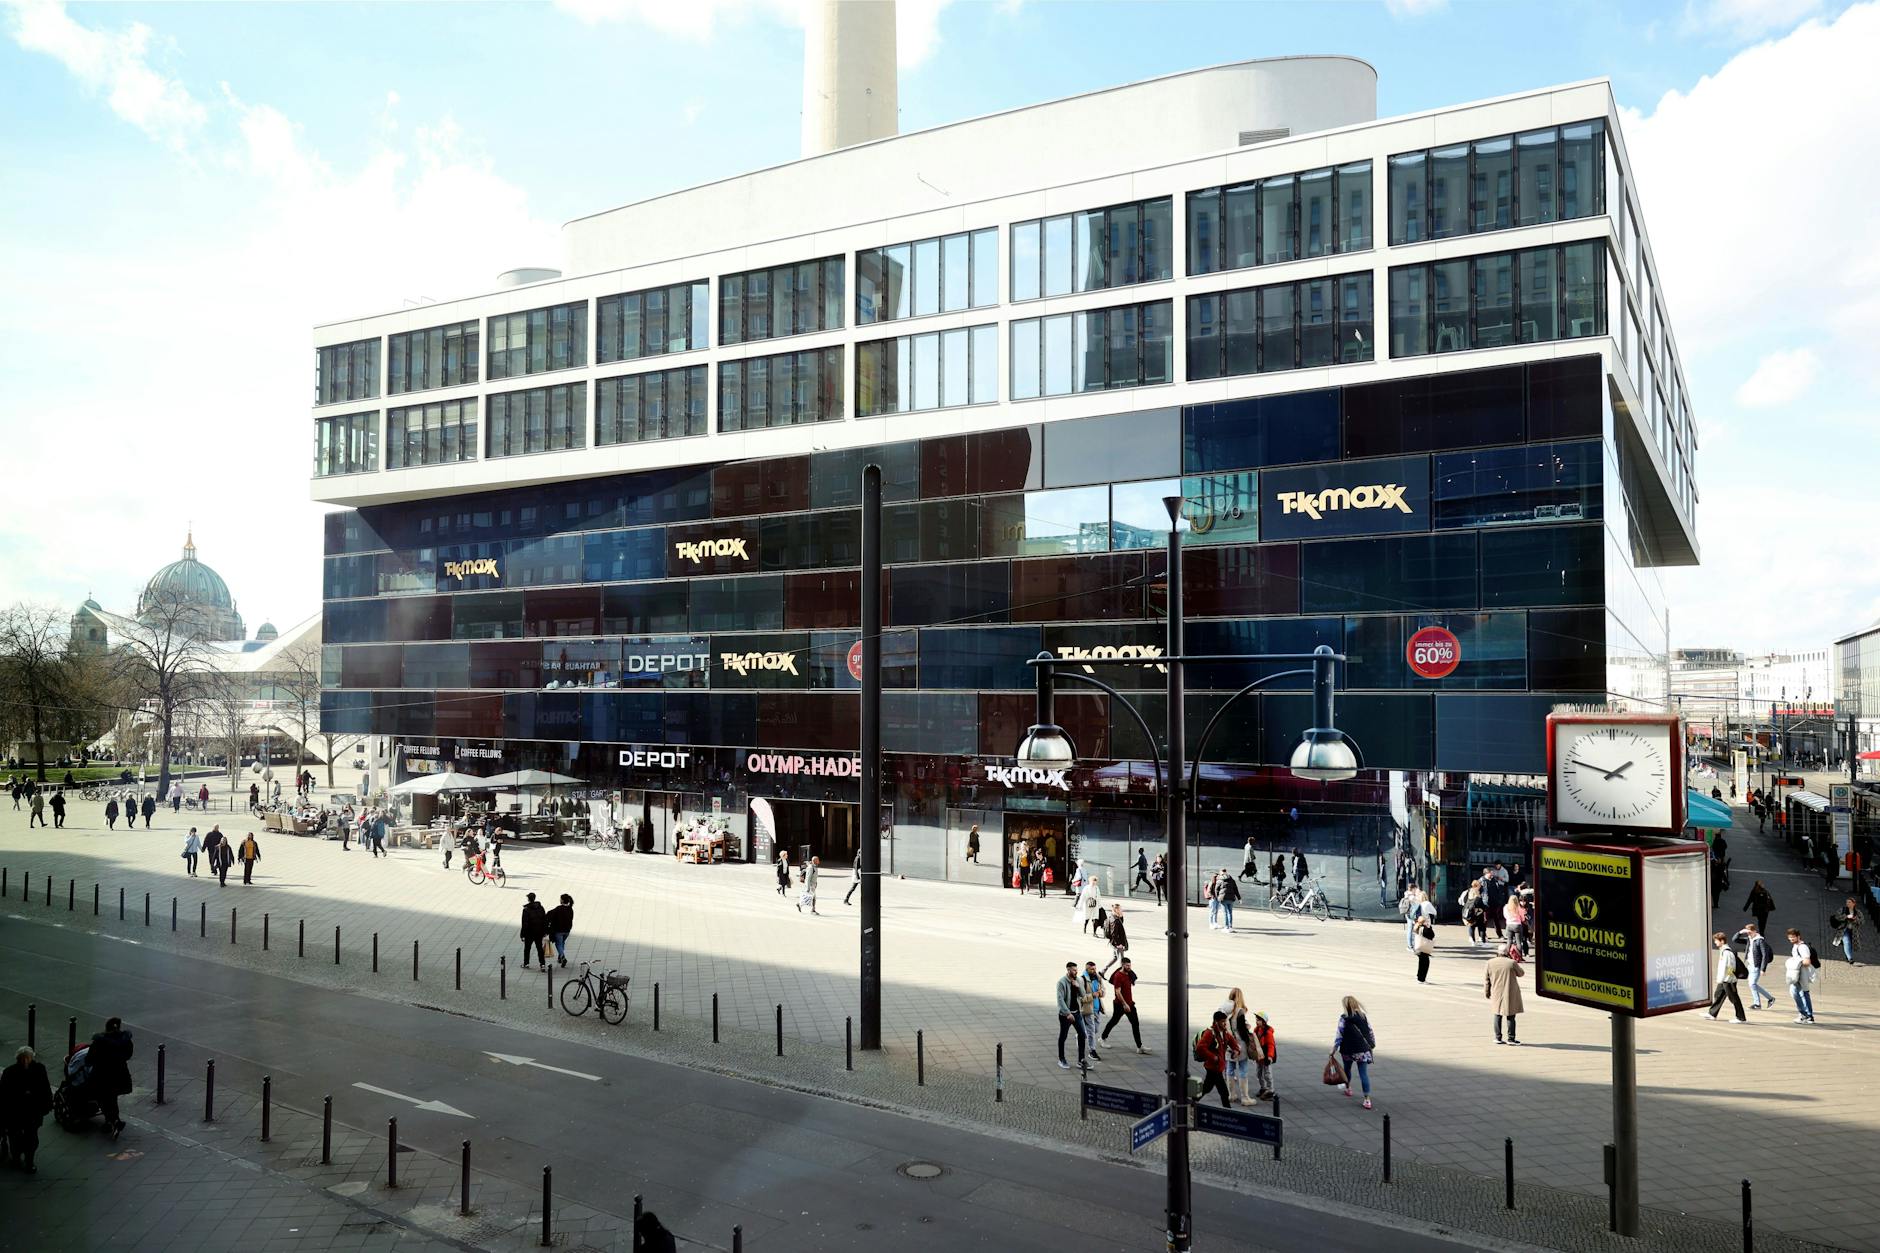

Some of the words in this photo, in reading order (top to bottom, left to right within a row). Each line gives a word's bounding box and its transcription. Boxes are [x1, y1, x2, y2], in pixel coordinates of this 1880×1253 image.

[628, 653, 709, 673] DEPOT
[1415, 647, 1453, 664] 60%
[403, 746, 419, 755] COFFEE
[420, 746, 441, 756] FELLOWS
[460, 748, 478, 758] COFFEE
[479, 748, 503, 759] FELLOWS
[619, 750, 690, 769] DEPOT
[747, 753, 861, 777] OLYMP&HADE
[1544, 857, 1629, 875] WWW.DILDOKING.DE
[1549, 921, 1626, 948] DILDOKING
[1548, 940, 1564, 950] SEX
[1565, 943, 1595, 955] MACHT
[1595, 948, 1628, 961] SCHÖN!
[1656, 966, 1695, 982] MUSEUM
[1546, 974, 1632, 999] WWW.DILDOKING.DE
[1659, 978, 1692, 993] BERLIN
